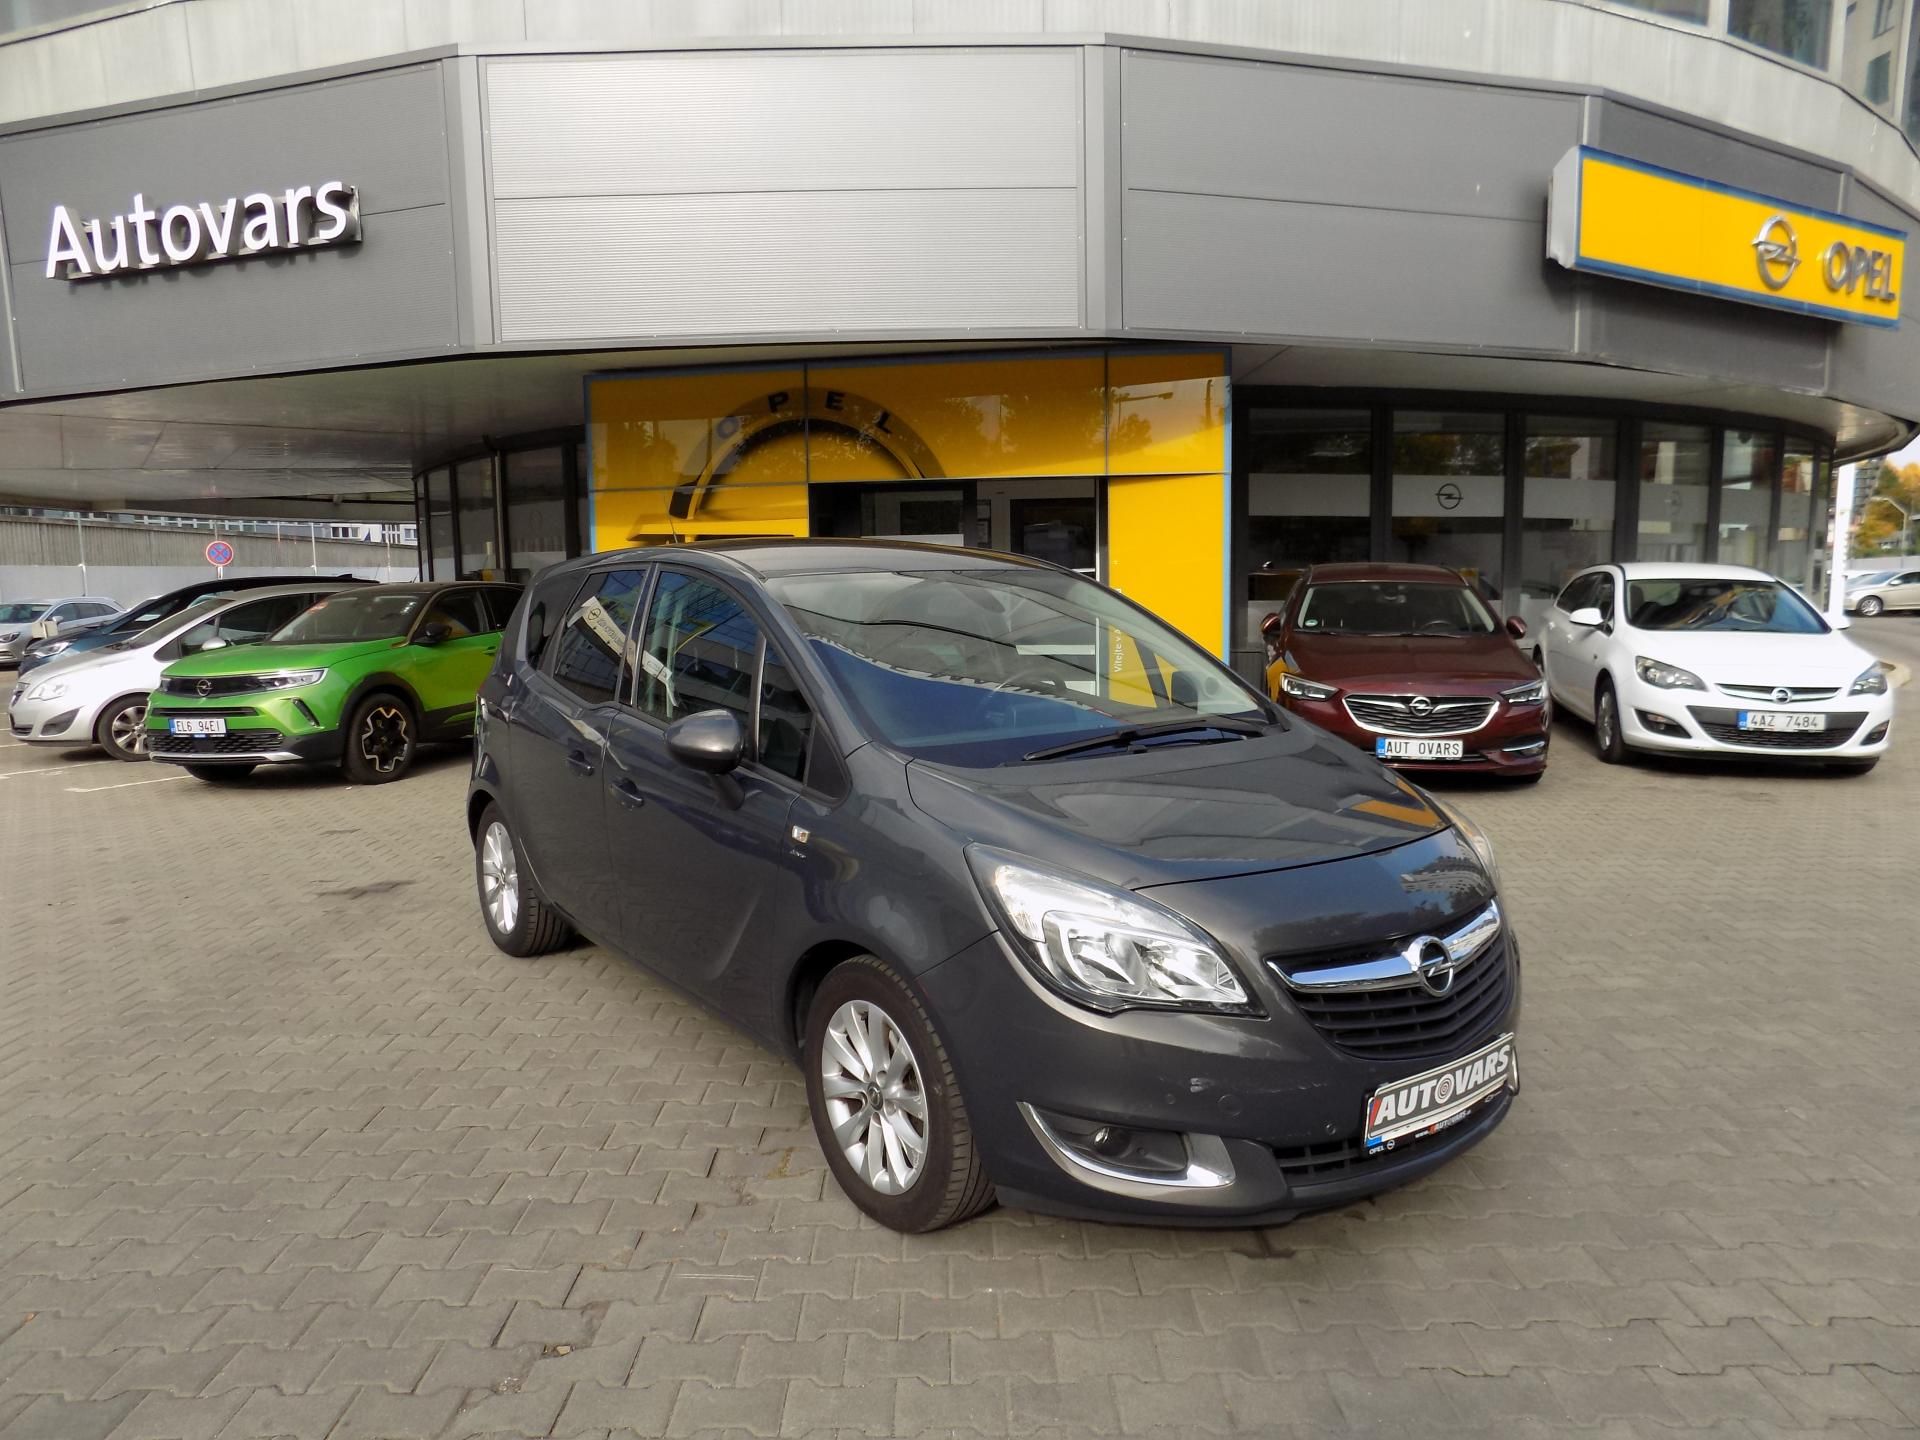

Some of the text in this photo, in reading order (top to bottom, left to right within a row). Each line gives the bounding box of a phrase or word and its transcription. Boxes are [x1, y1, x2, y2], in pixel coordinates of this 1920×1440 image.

[46, 180, 348, 279] Autovars
[1822, 240, 1897, 302] OPEL
[716, 390, 893, 440] OPEL
[176, 720, 192, 732] EL6
[1750, 714, 1776, 728] 4AZ
[1785, 715, 1818, 729] 7484
[1386, 741, 1460, 756] AUT OVARS
[1373, 1044, 1511, 1125] AUTOVARS
